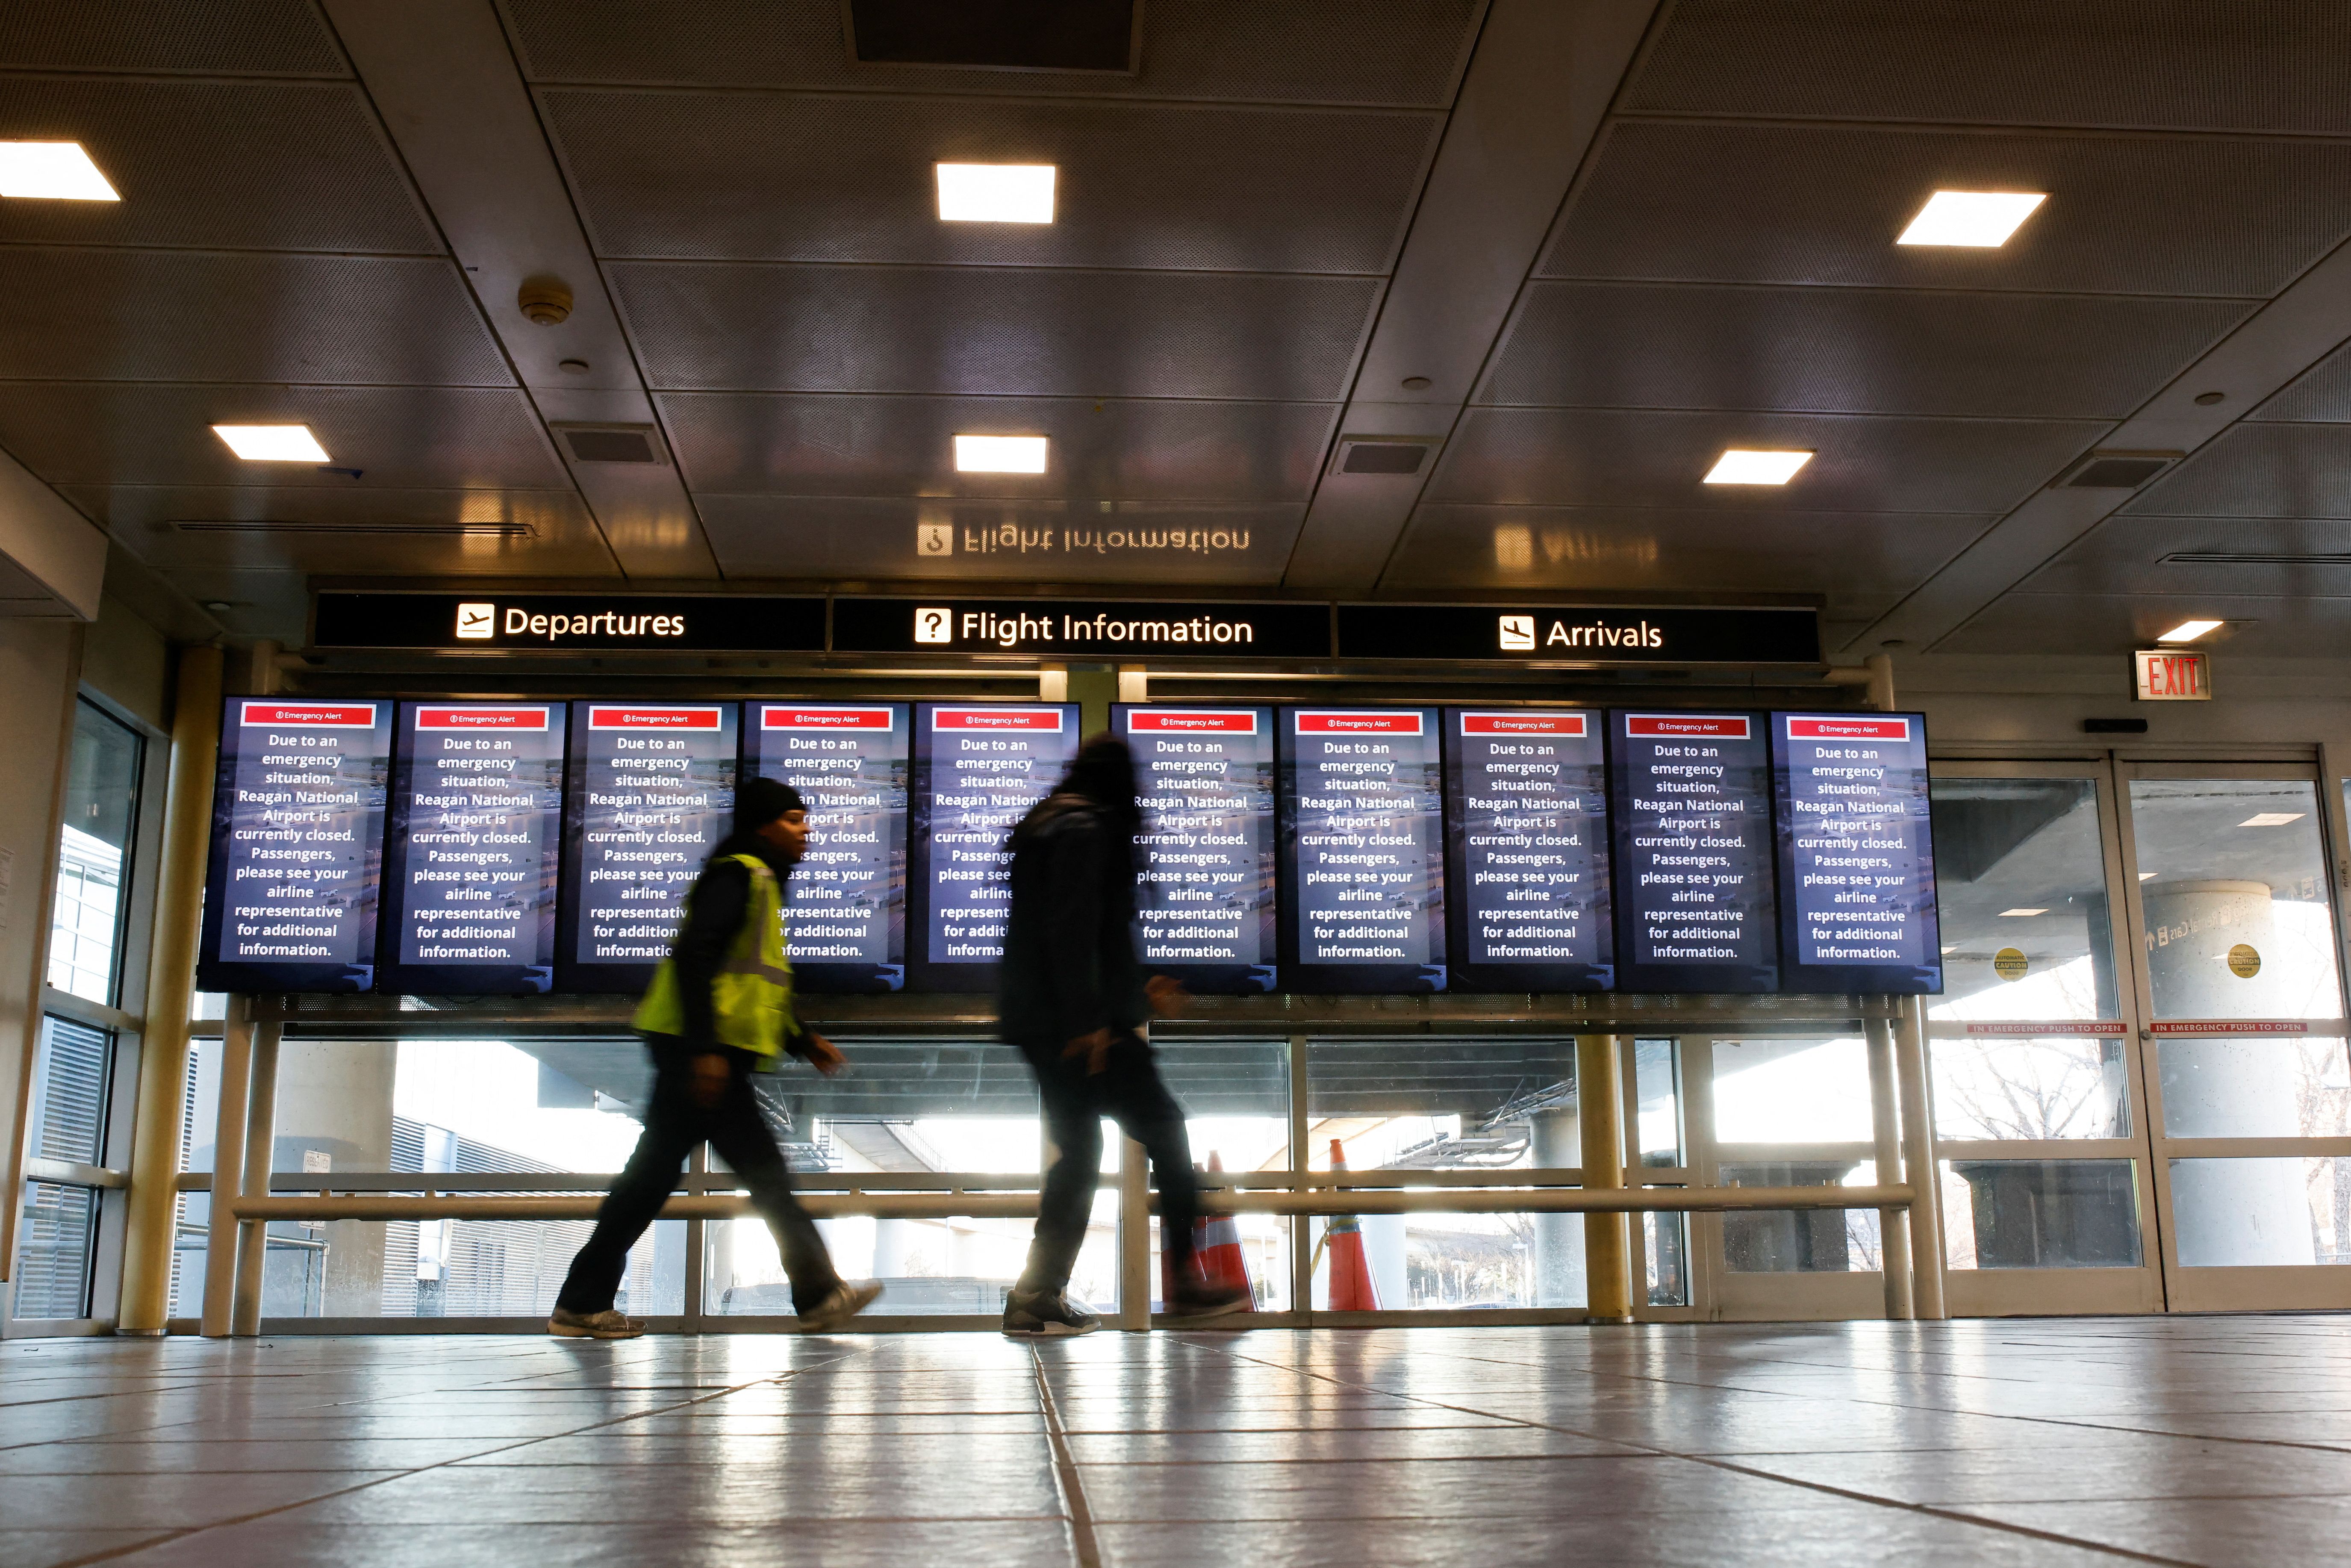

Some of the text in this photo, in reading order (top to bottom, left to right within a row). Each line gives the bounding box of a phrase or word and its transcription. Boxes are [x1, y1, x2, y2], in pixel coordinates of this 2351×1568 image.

[506, 609, 683, 640] Departures
[963, 613, 1252, 646] Flight Information
[1547, 621, 1662, 647] Arrivals
[2148, 658, 2198, 694] EXIT
[285, 712, 323, 720] Emergency
[804, 716, 842, 724] Emergency
[269, 735, 297, 746] Due
[301, 736, 315, 746] to
[444, 739, 511, 749] Due to an
[790, 738, 817, 749] Due
[821, 740, 835, 749] to
[1325, 743, 1389, 753] Due to an
[1491, 744, 1553, 755] Due to an
[1816, 748, 1841, 758] Due
[1844, 749, 1858, 758] to
[262, 756, 341, 768] emergency
[438, 759, 516, 771] emergency
[784, 759, 861, 771] emergency
[1320, 763, 1394, 774] emergency
[1486, 764, 1559, 775] emergency
[1812, 768, 1883, 779] emergency
[266, 772, 334, 785] situation,
[442, 775, 509, 788] situation,
[1326, 778, 1390, 791] situation,
[1492, 779, 1555, 792] situation,
[1818, 783, 1880, 796] situation,
[239, 791, 358, 805] Reagan National
[416, 794, 533, 808] Reagan National
[1302, 797, 1414, 811] Reagan National
[1469, 798, 1579, 811] Reagan National
[1797, 801, 1903, 814] Reagan National
[263, 810, 330, 824] Airport is
[439, 813, 506, 827] Airport is
[1327, 815, 1390, 830] Airport is
[1494, 816, 1556, 830] Airport is
[1821, 819, 1881, 833] Airport is
[236, 829, 354, 843] currently closed.
[413, 831, 531, 846] currently closed.
[1302, 834, 1415, 848] currently closed.
[1470, 834, 1581, 848] currently closed.
[1798, 837, 1906, 851] currently closed.
[252, 848, 335, 862] Passengers,
[430, 851, 512, 865] Passengers,
[1320, 853, 1399, 866] Passengers,
[1488, 853, 1566, 867] Passengers,
[1815, 855, 1891, 869] Passengers,
[236, 866, 348, 881] please see your
[415, 869, 525, 884] please see your
[1308, 871, 1412, 885] please see your
[1476, 871, 1579, 885] please see your
[1804, 873, 1904, 887] please see your
[268, 886, 314, 897] airline
[446, 888, 492, 900] airline
[1339, 889, 1382, 900] airline
[1507, 889, 1550, 900] airline
[1835, 892, 1876, 902] airline
[236, 906, 342, 919] representative
[415, 908, 520, 922] representative
[1311, 908, 1411, 922] representative
[1479, 908, 1579, 922] representative
[1809, 911, 1905, 923] representative
[238, 924, 336, 936] for additional
[417, 926, 515, 938] for additional
[1314, 927, 1407, 938] for additional
[1483, 926, 1575, 937] for additional
[1812, 928, 1902, 940] for additional
[240, 943, 330, 955] information.
[420, 946, 510, 957] information.
[1319, 946, 1405, 957] information.
[1488, 945, 1573, 956] information.
[1817, 946, 1900, 958] information.
[306, 1156, 328, 1169] RESERVED
